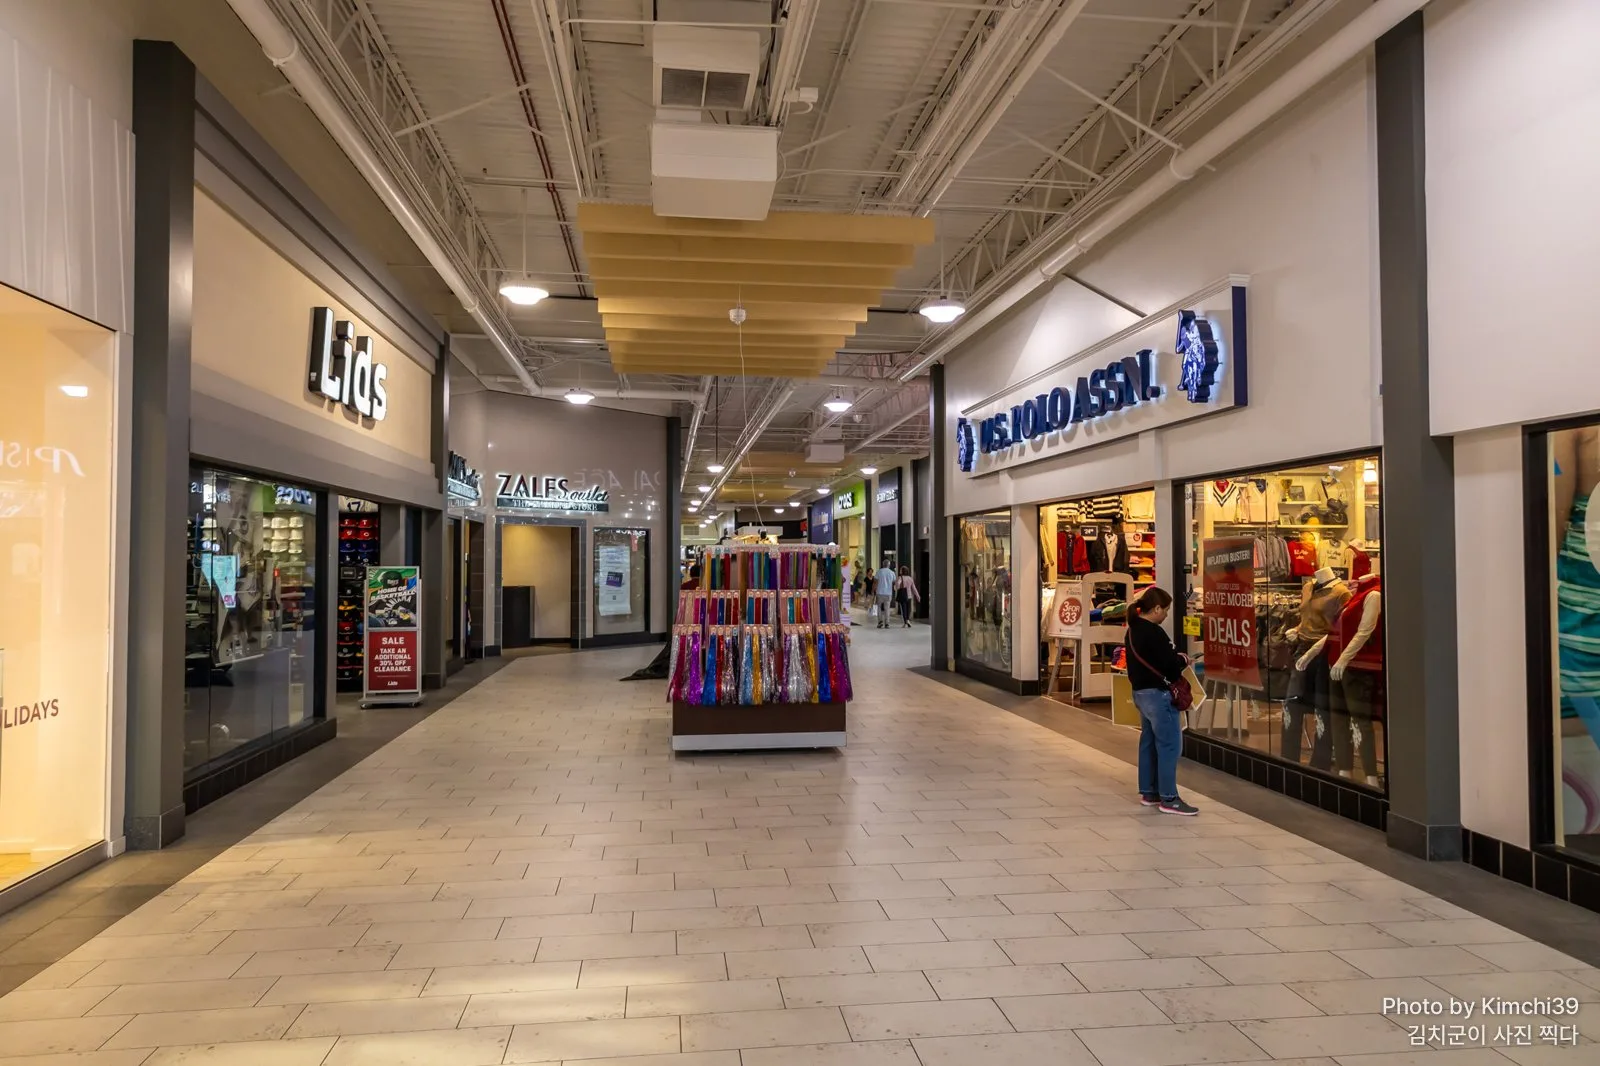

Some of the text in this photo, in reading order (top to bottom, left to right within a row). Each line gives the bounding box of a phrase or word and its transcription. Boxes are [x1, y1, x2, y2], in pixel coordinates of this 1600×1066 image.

[308, 306, 387, 421] Lids
[1010, 387, 1071, 444] POLO
[1070, 349, 1160, 424] ASSN.
[496, 473, 569, 501] ZALES
[569, 485, 610, 502] outlet
[1205, 592, 1253, 608] SAVE MORE
[382, 637, 405, 645] SALE
[1209, 616, 1251, 648] DEALS
[4, 698, 59, 729] LIDAYS
